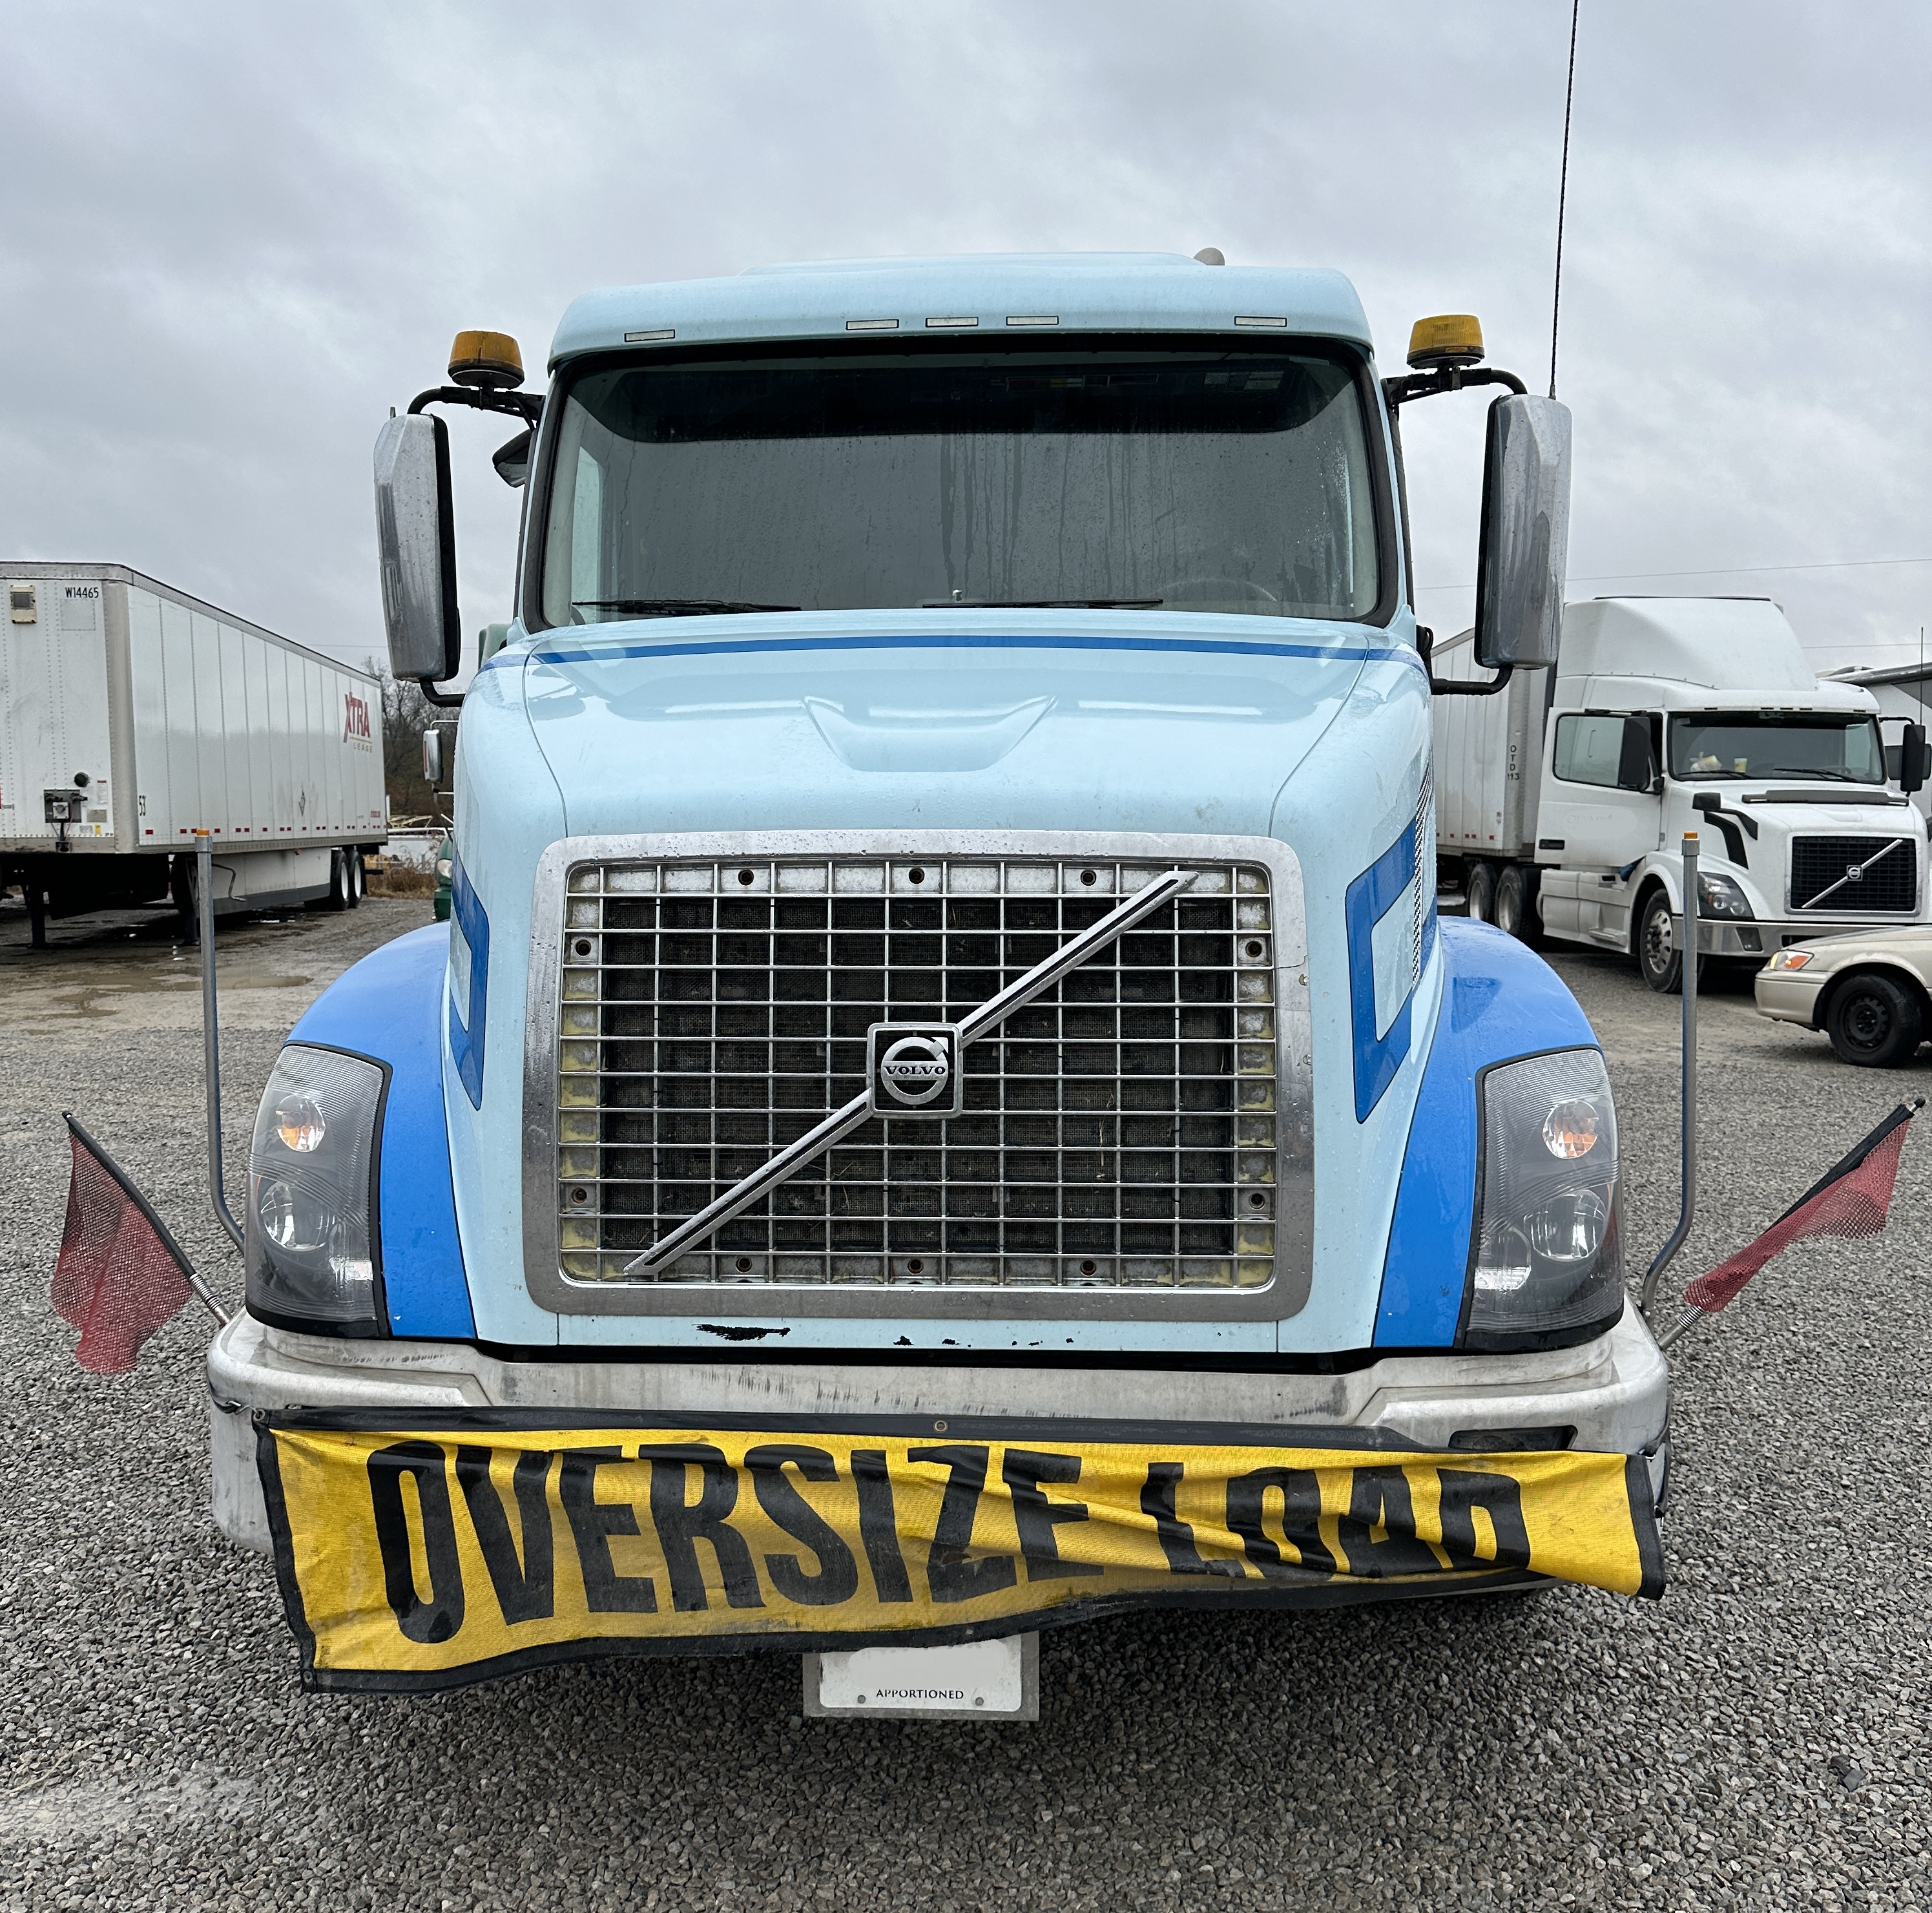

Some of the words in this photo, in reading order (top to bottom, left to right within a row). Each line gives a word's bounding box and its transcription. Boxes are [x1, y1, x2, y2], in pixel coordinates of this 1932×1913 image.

[65, 587, 99, 598] W14465
[343, 691, 370, 743] XTRA
[353, 742, 373, 753] LEASE
[138, 795, 147, 817] 53
[883, 1066, 946, 1076] VOLVO
[366, 1440, 1105, 1644] OVERSIZE
[876, 1688, 964, 1700] APPORTIONED
